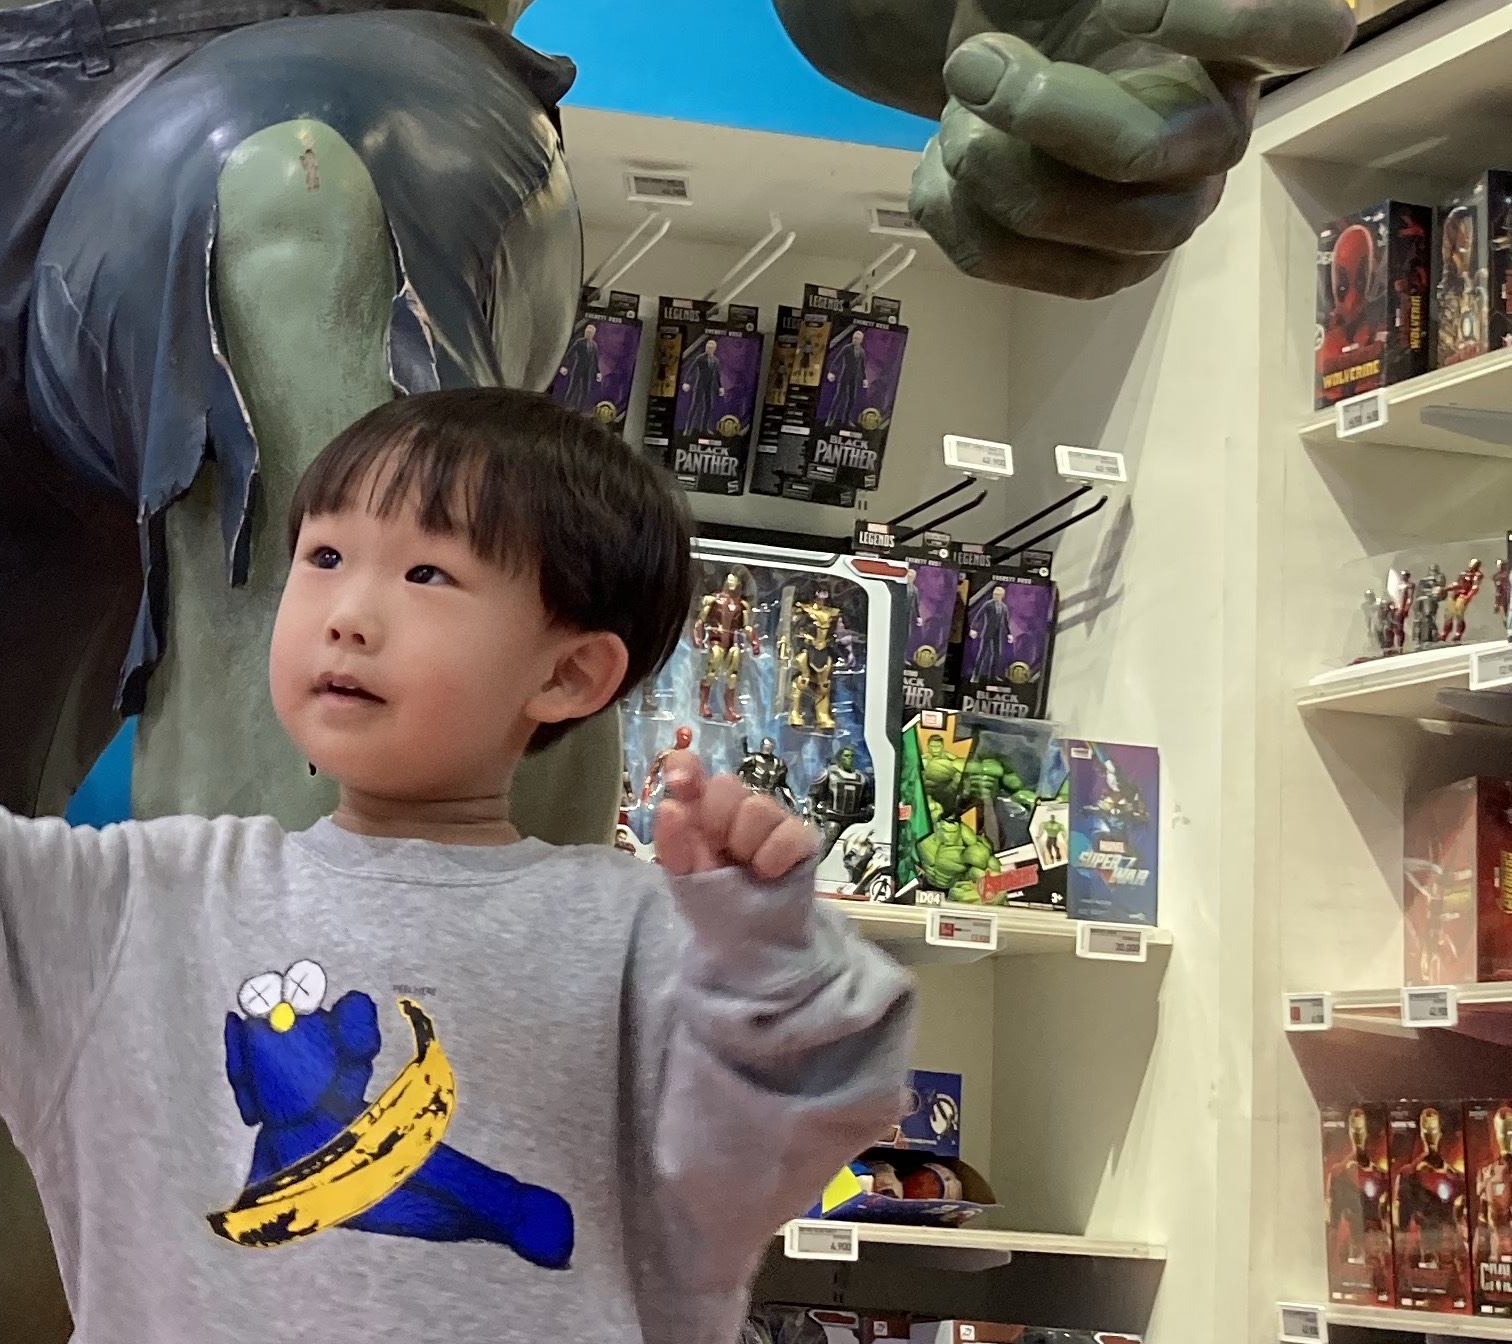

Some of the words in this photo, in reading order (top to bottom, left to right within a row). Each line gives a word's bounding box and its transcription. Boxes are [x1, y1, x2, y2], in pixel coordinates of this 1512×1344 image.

[689, 442, 730, 456] BLACK
[829, 434, 869, 450] BLACK
[674, 448, 739, 477] PANTHER
[814, 439, 878, 472] PANTHER
[859, 530, 896, 548] LEGENDS
[903, 676, 925, 687] ACK
[903, 686, 934, 708] THER
[976, 690, 1019, 703] BLACK
[1078, 850, 1123, 868] SUPER
[1112, 867, 1150, 887] WAR
